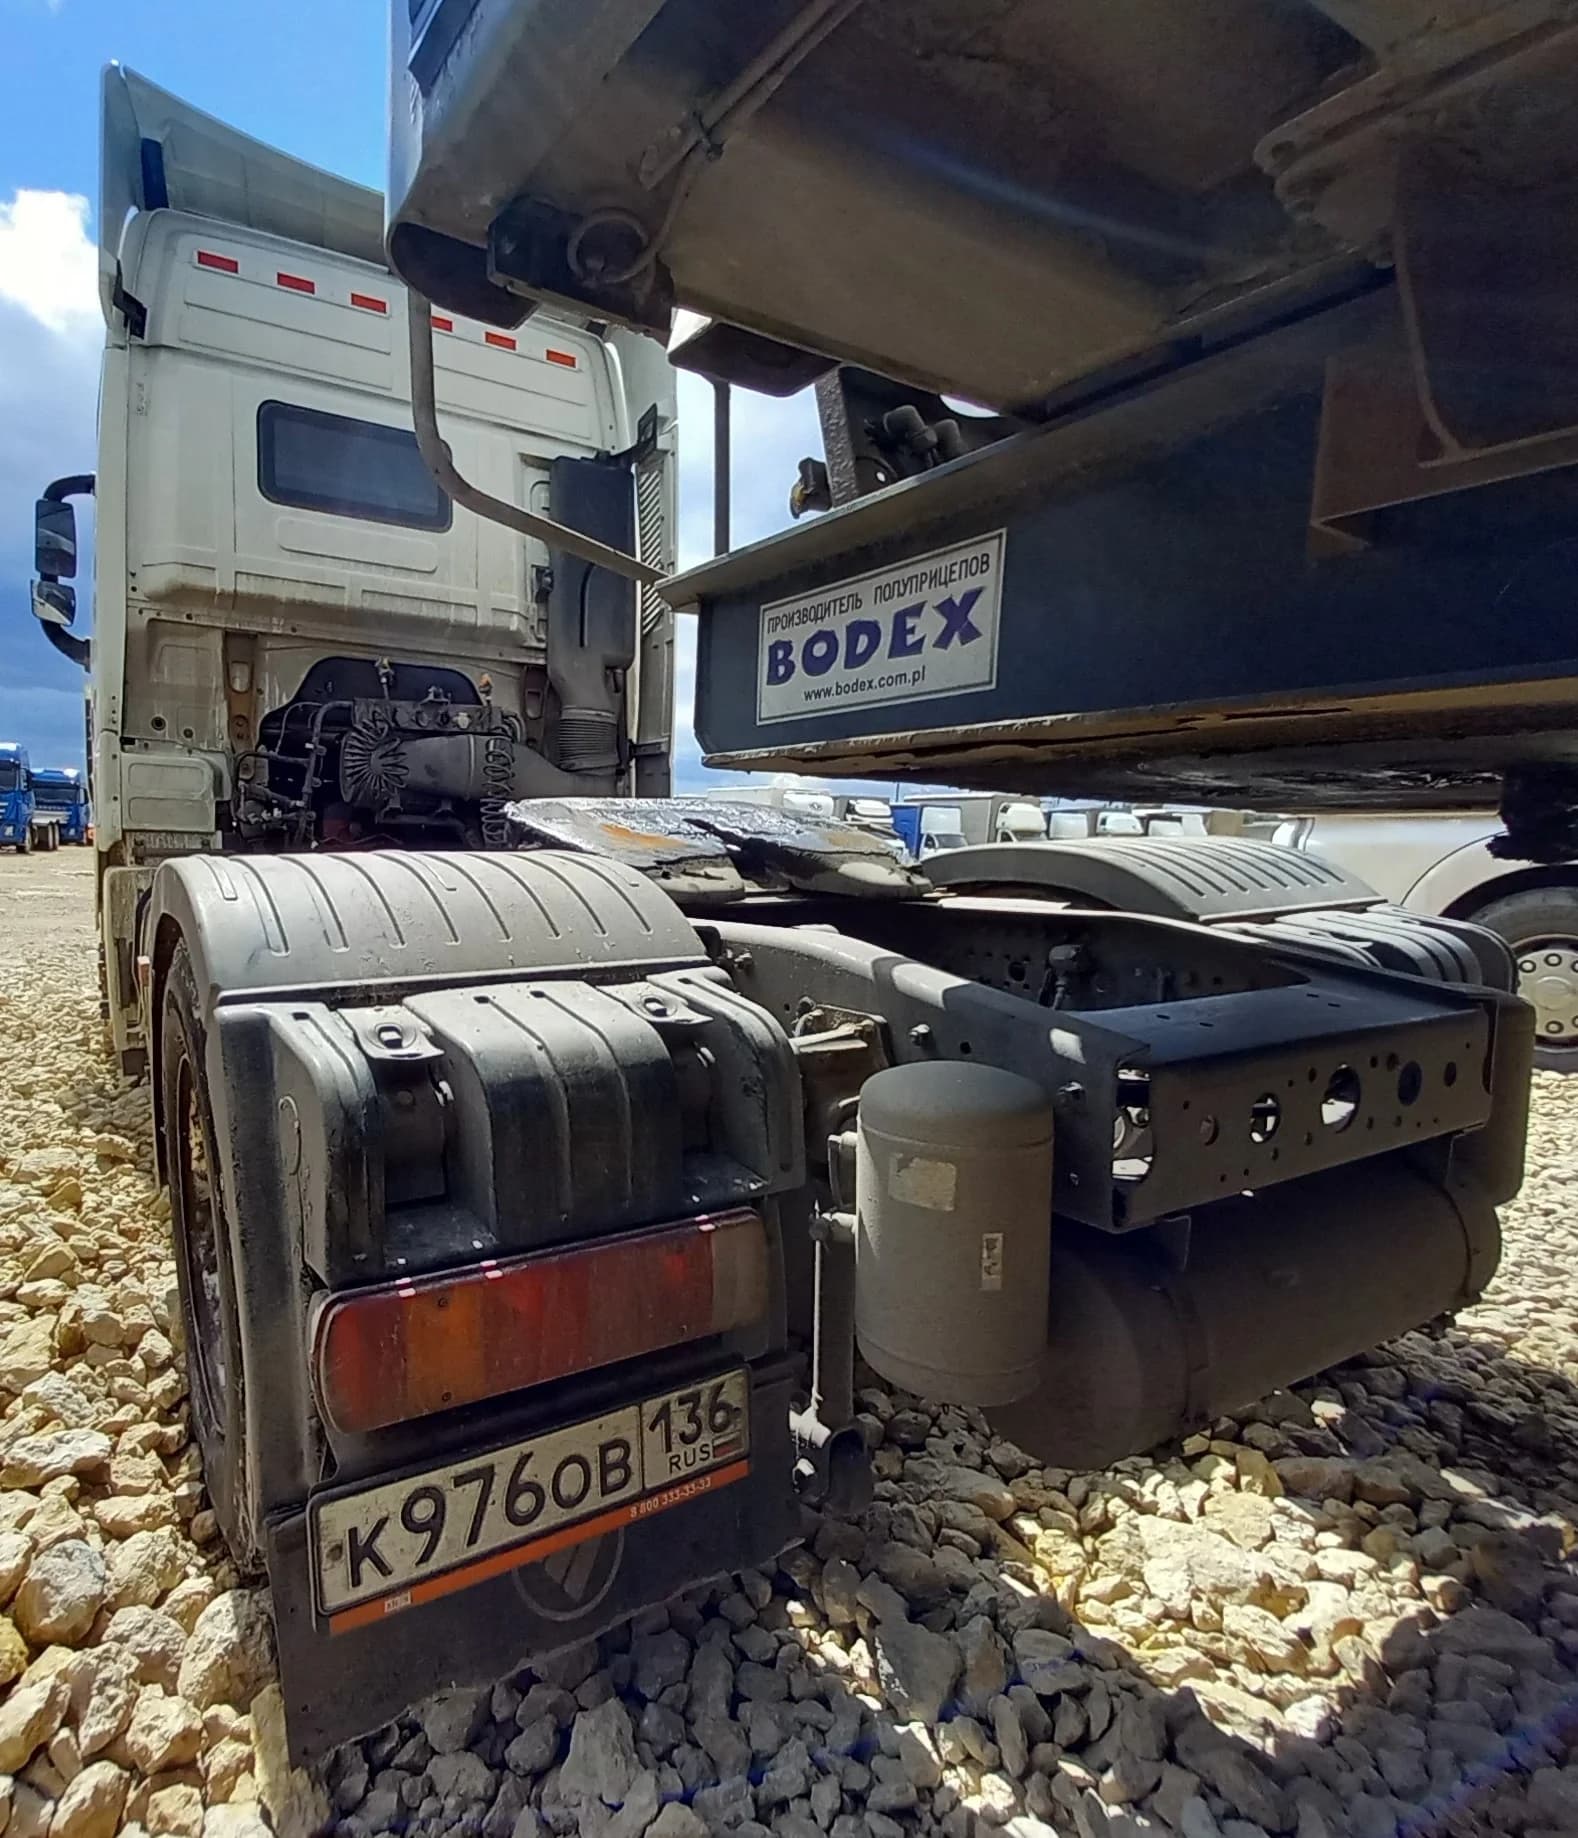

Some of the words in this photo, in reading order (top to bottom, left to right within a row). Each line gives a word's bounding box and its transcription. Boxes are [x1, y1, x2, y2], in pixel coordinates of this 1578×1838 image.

[767, 592, 863, 634] ПРОИЗВОДИТЕЛЬ
[874, 553, 990, 605] ПОЛУПРИЦЕПОВ
[766, 586, 986, 686] BODEX
[803, 665, 926, 701] www.bodex.com.pl
[669, 1443, 711, 1474] RUS
